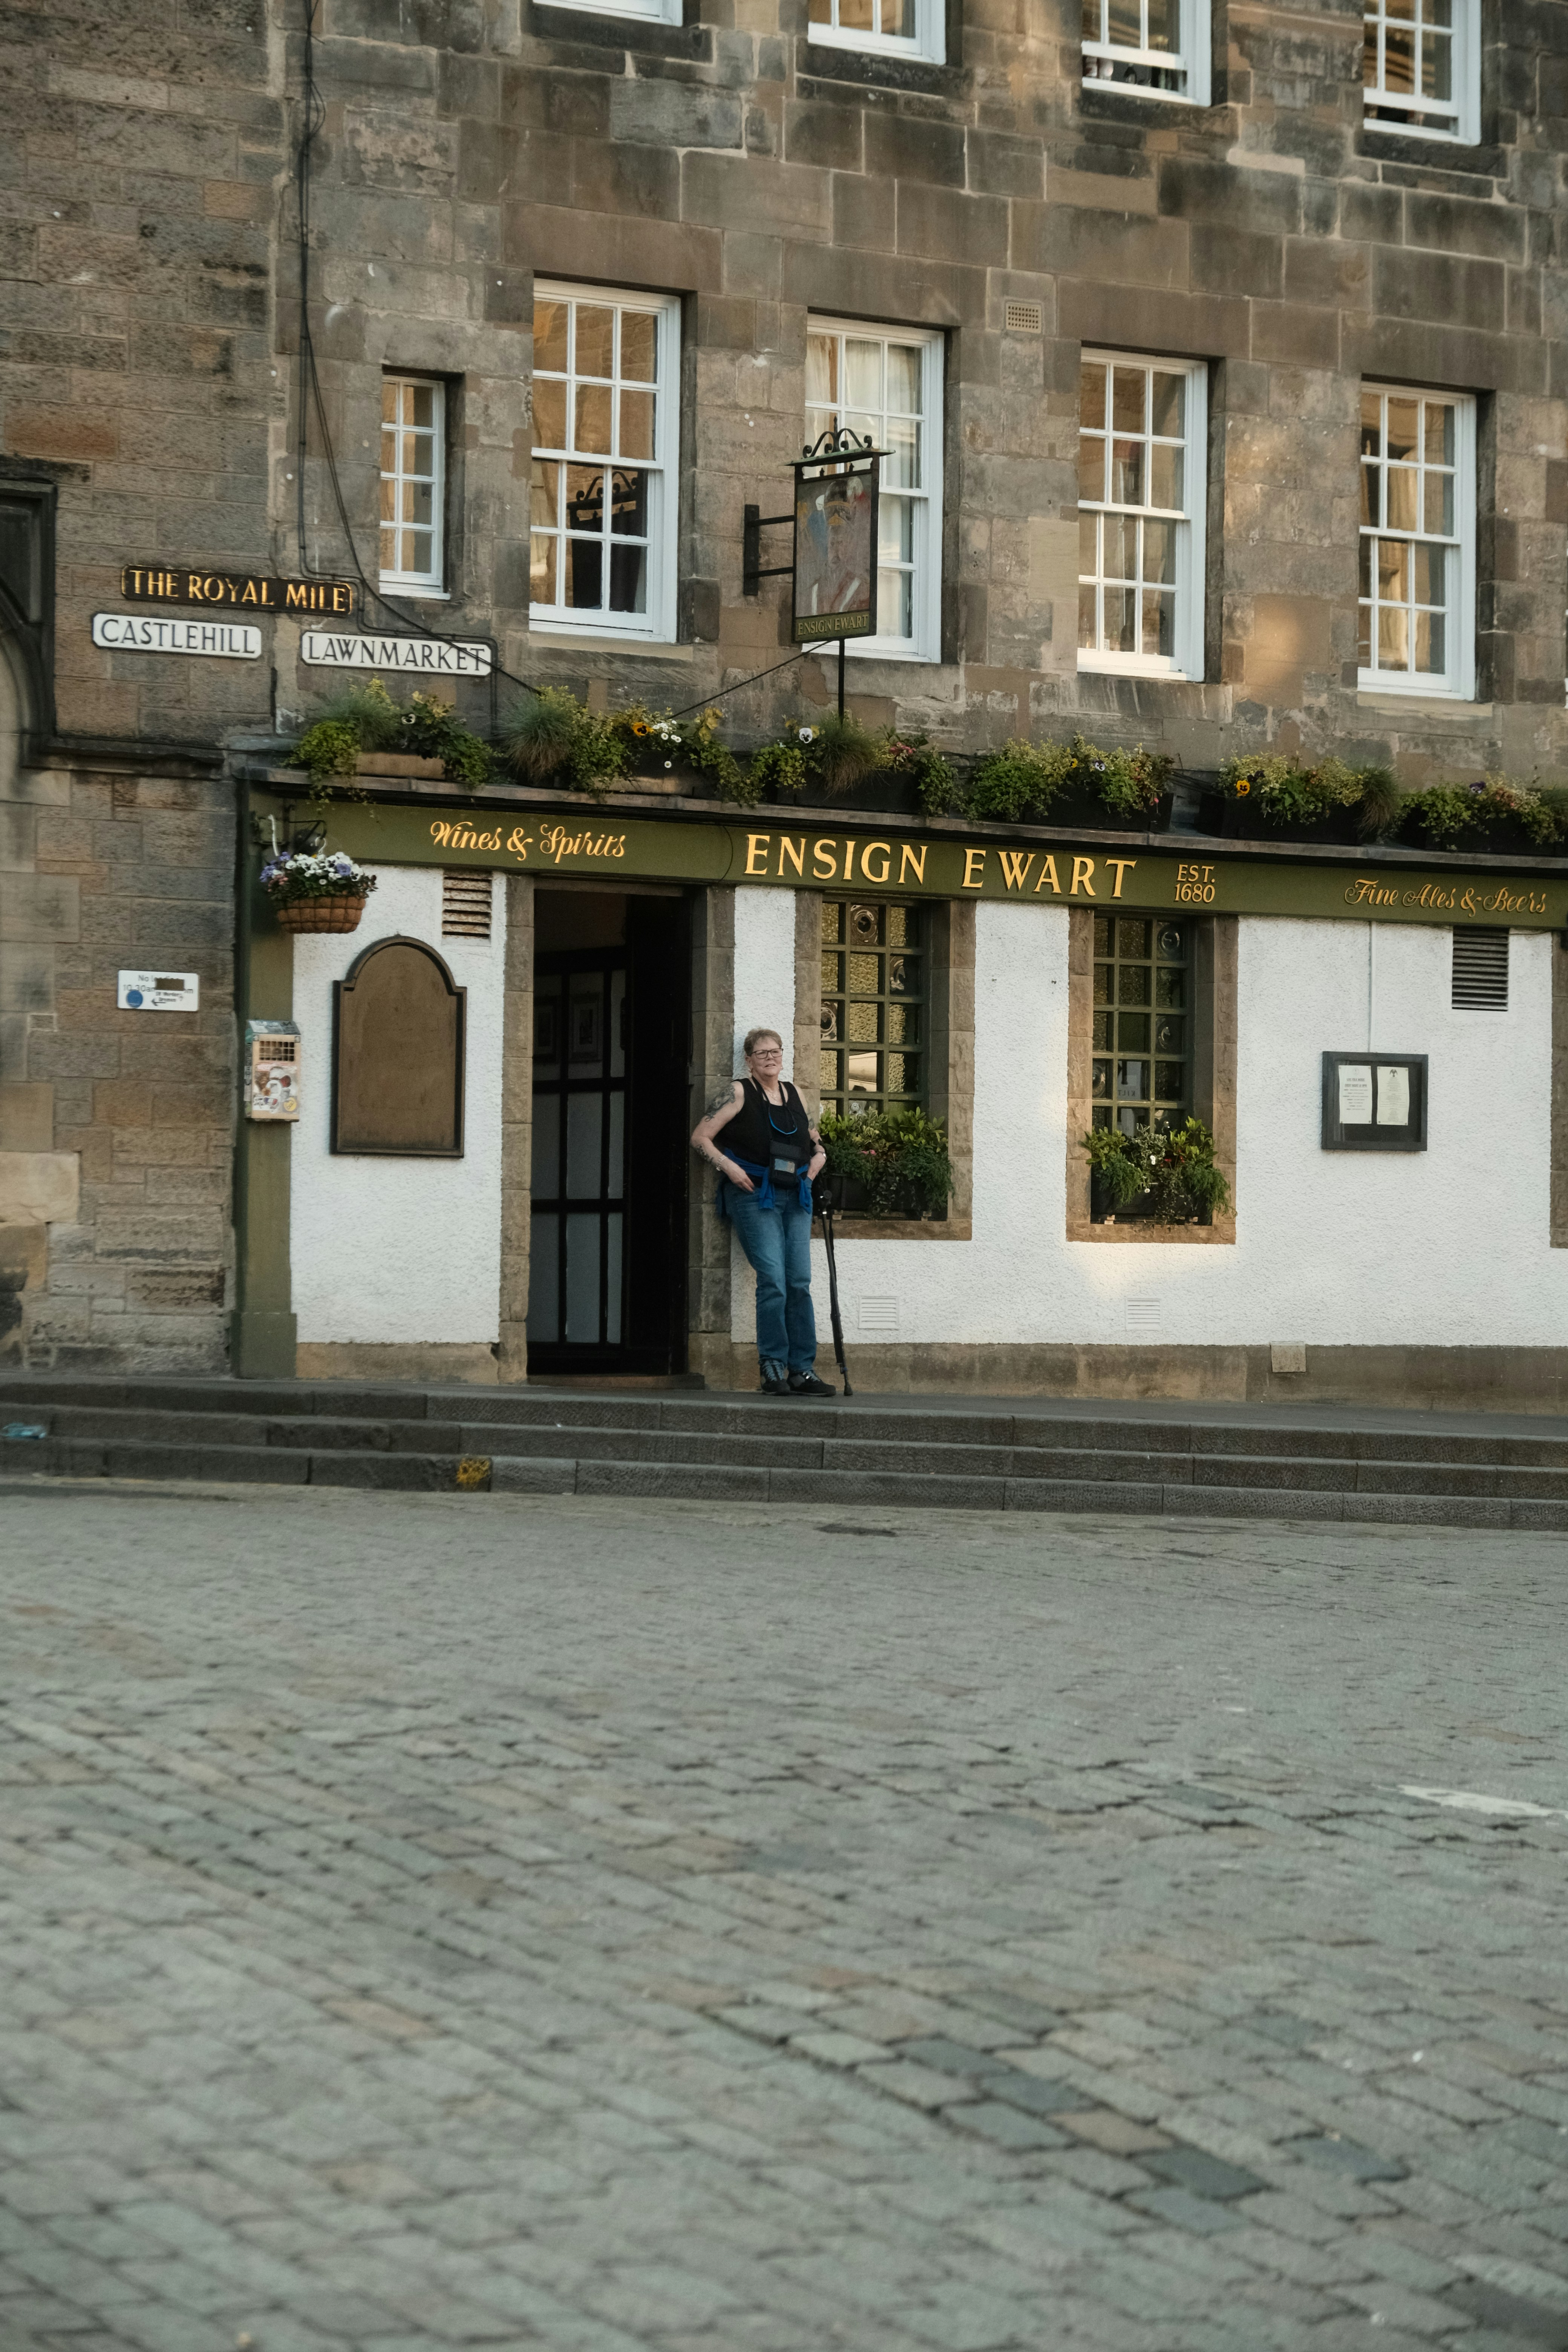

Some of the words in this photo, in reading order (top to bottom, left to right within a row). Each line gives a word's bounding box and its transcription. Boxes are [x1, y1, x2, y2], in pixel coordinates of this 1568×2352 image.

[129, 570, 178, 598] THE
[188, 575, 275, 606] ROYAL
[285, 583, 346, 611] MILE
[101, 619, 256, 654] CASTLEHILL
[798, 619, 831, 635] ENSIGN
[835, 614, 868, 631] EWART
[308, 636, 485, 671] LAWNMARKET
[430, 821, 502, 850] Wines
[507, 827, 533, 861] &
[540, 824, 626, 864] Spirits
[744, 834, 927, 884] ENSIGN
[962, 849, 1137, 898] EWART
[1177, 864, 1216, 884] EST.
[1174, 883, 1216, 904] 1680
[1344, 879, 1399, 906] Fine
[1402, 884, 1456, 909] Ales
[1460, 888, 1482, 917] &
[1483, 887, 1547, 913] Beers
